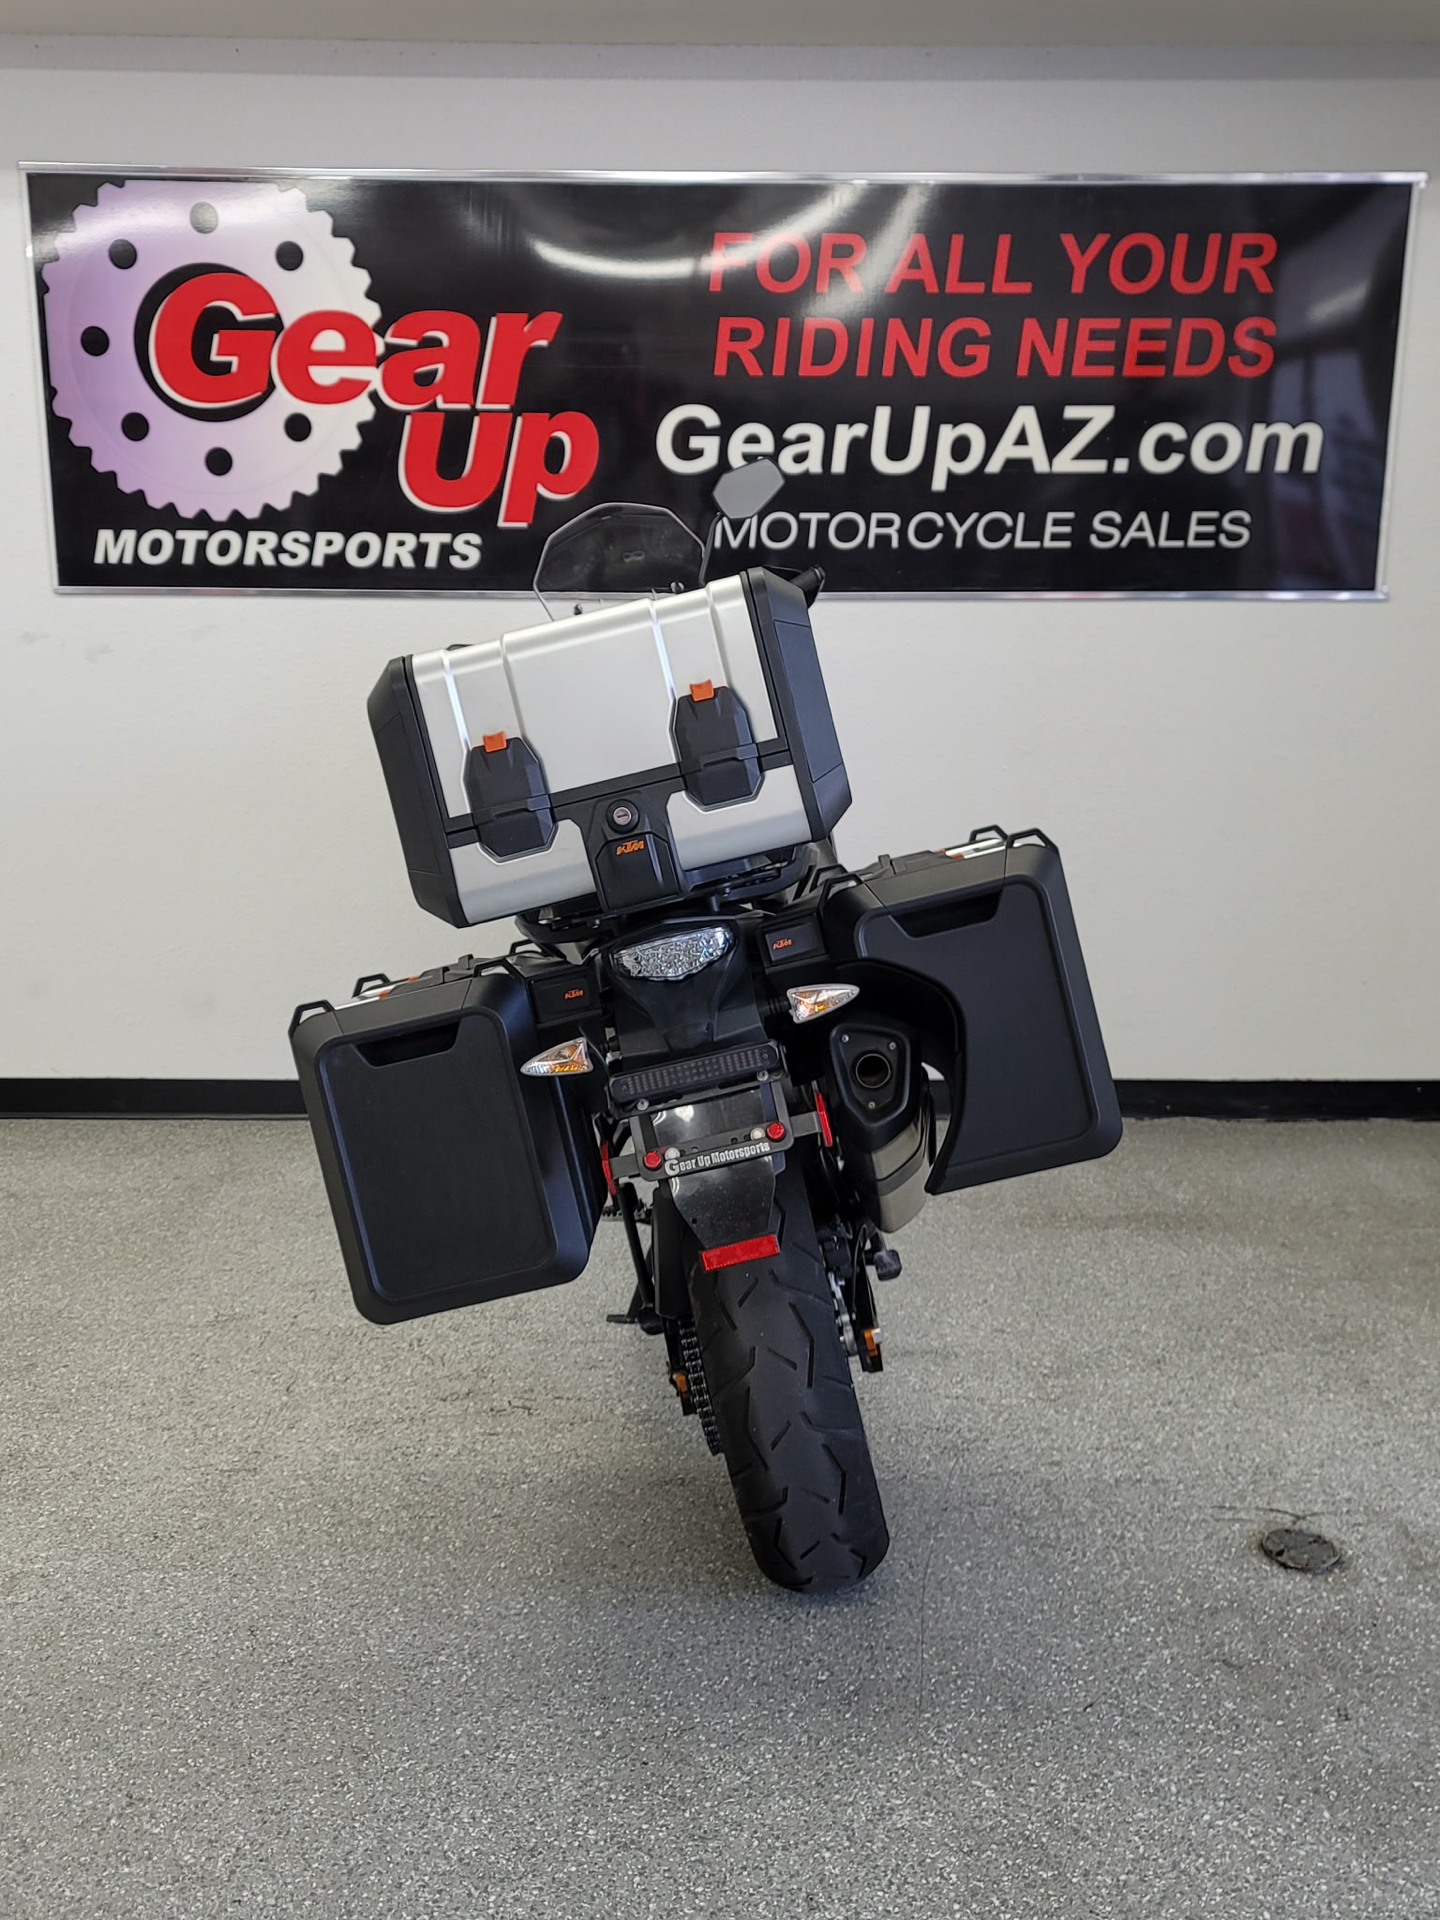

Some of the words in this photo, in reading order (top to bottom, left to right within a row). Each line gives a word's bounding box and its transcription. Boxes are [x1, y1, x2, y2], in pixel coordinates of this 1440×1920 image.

[709, 233, 866, 292] FOR
[885, 233, 1034, 294] ALL
[1059, 233, 1277, 294] YOUR
[149, 272, 563, 410] Gear
[713, 317, 992, 377] RIDING
[1016, 317, 1277, 377] NEEDS
[397, 410, 600, 528] Up
[656, 404, 1325, 492] GearUpAZ.com
[93, 529, 482, 570] MOTORSPORTS
[714, 511, 1075, 549] MOTORCYCLE
[1090, 511, 1252, 549] SALES
[617, 839, 645, 855] KTM
[773, 938, 792, 950] KTM
[664, 1159, 696, 1176] Gear
[698, 1155, 712, 1168] Up
[712, 1142, 771, 1163] Motorsports
